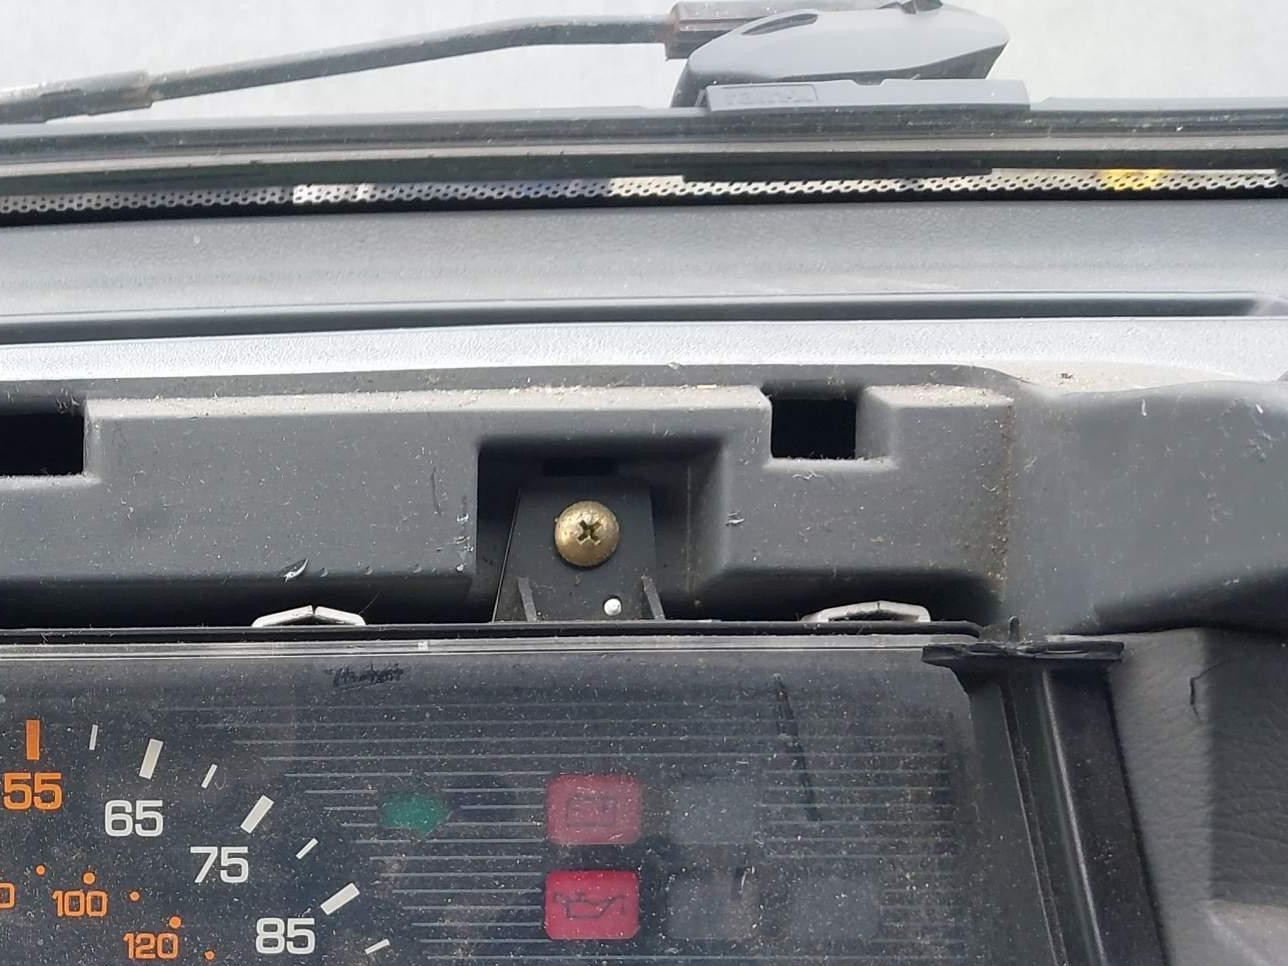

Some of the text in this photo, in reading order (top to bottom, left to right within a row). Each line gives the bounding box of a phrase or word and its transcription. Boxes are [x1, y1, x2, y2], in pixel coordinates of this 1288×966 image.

[2, 772, 64, 812] 55
[103, 799, 164, 838] 65
[189, 845, 250, 884] 75
[52, 890, 109, 918] 100
[123, 932, 179, 960] 120
[255, 917, 316, 955] 85
